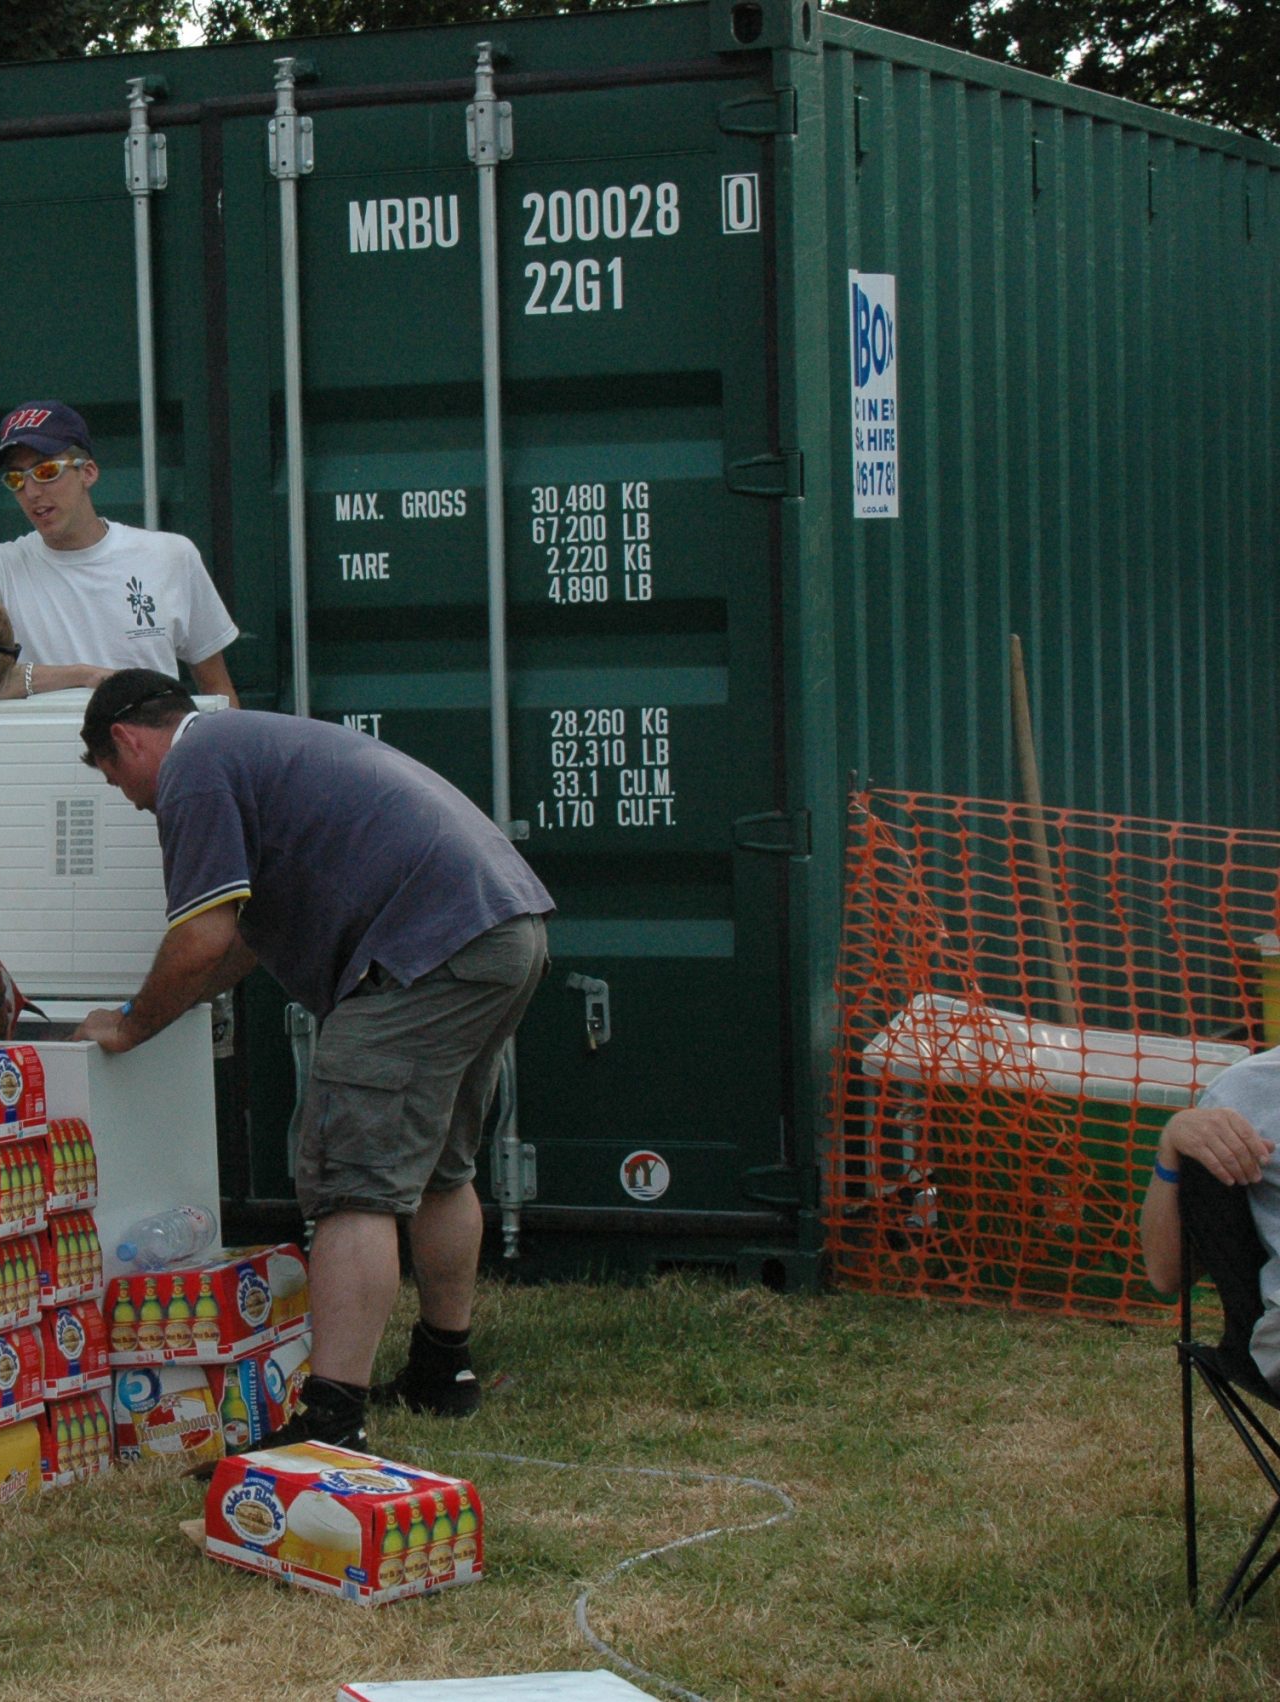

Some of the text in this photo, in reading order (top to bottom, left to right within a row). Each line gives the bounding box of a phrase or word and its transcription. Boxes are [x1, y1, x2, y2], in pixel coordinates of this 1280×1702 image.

[349, 195, 459, 253] MRBU
[522, 182, 679, 246] 200028
[524, 256, 623, 315] 22G1
[335, 489, 466, 521] MAX. GROSS
[531, 482, 649, 515] 30,480 KG
[531, 512, 650, 544] 67,200 LB
[339, 552, 390, 581] TARE
[546, 543, 651, 575] 2,220 KG
[548, 573, 652, 605] 4,890 LB
[550, 707, 668, 738] 28,260 KG
[551, 738, 669, 768] 62,310 LB
[553, 768, 675, 798] 33.1 CU.M.
[537, 798, 676, 830] 1,170 CU.FT.
[225, 1487, 285, 1531] Bière Blonde
